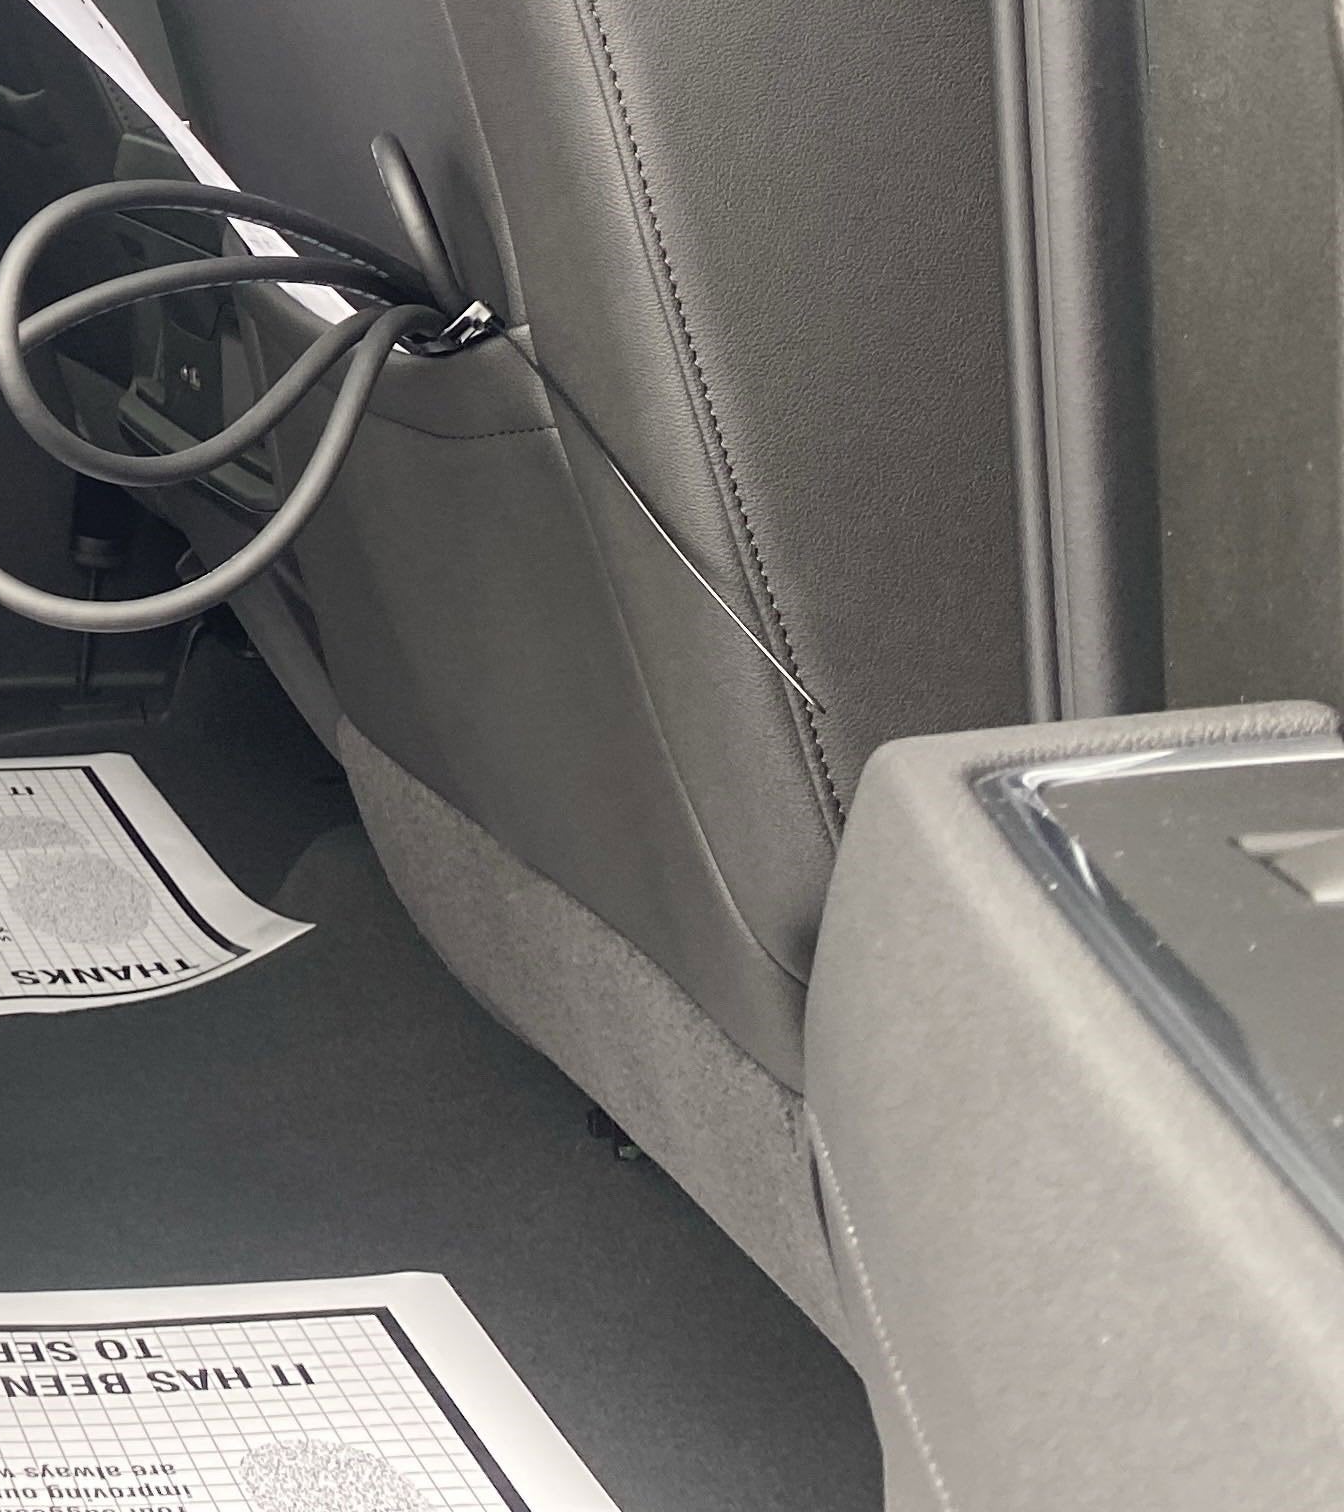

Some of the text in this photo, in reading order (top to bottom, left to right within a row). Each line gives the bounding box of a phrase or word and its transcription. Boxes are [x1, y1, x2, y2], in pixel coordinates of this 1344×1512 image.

[8, 786, 35, 796] IT
[11, 958, 199, 986] THANKS
[94, 1337, 163, 1362] TO
[5, 1370, 132, 1399] BEEN
[146, 1365, 253, 1394] HAS
[271, 1361, 315, 1387] IT
[23, 1464, 123, 1480] always
[130, 1464, 177, 1476] are
[45, 1483, 193, 1502] improving
